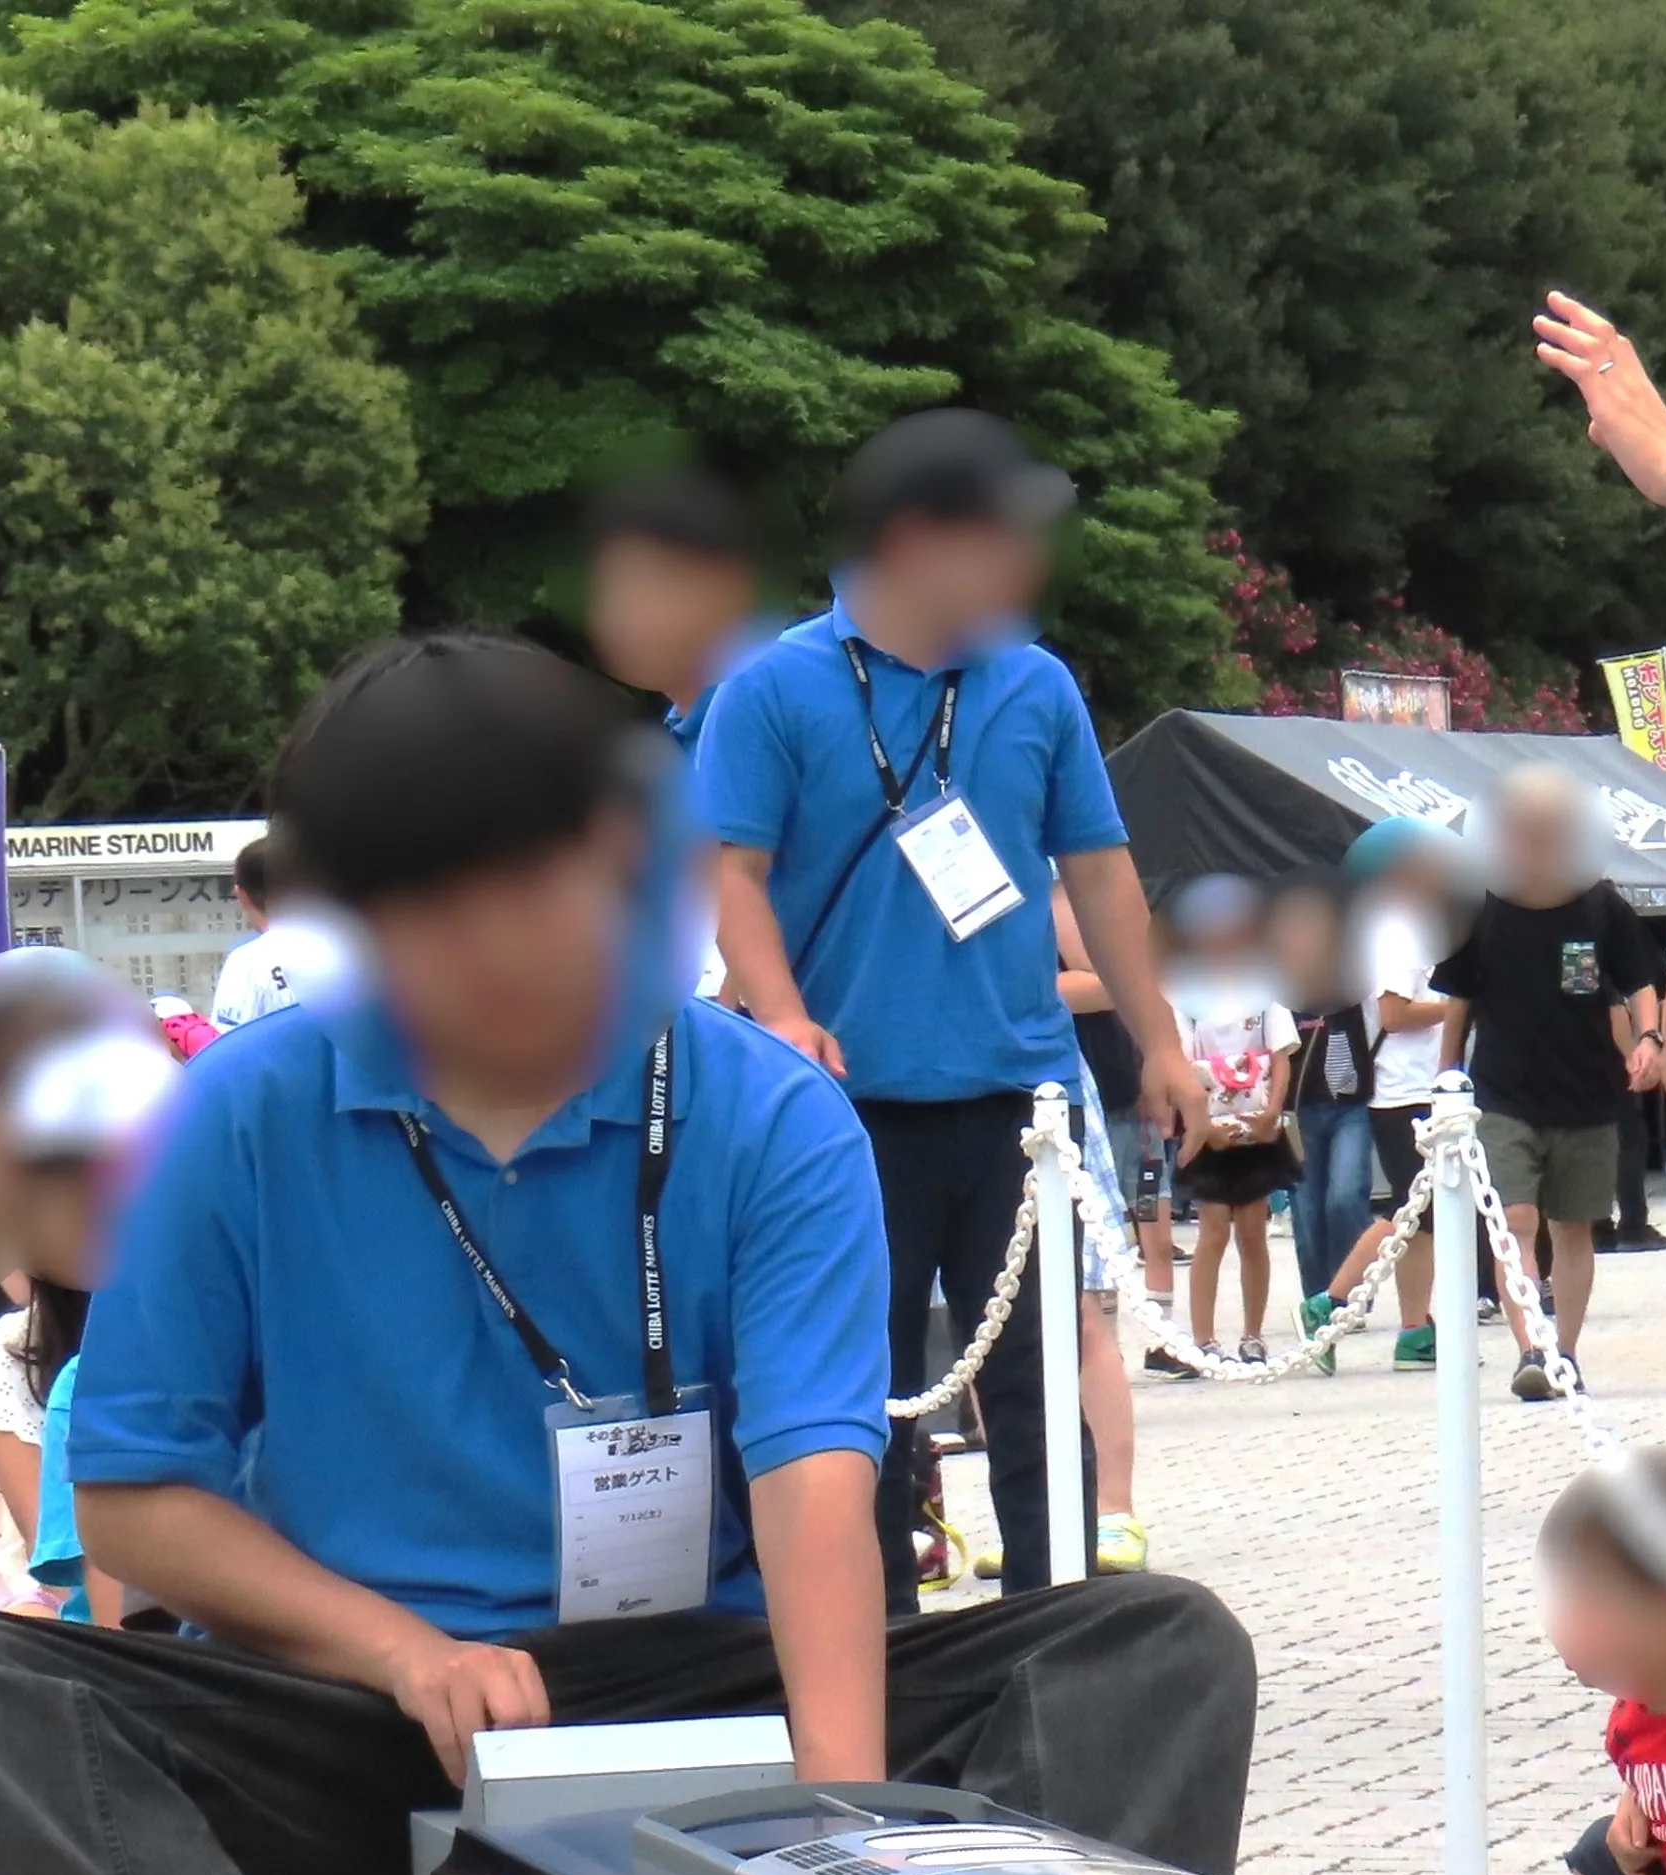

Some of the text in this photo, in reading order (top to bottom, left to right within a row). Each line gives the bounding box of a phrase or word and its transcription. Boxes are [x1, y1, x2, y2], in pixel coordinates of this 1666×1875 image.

[8, 835, 103, 858] MARINE
[106, 830, 214, 854] STADIUM
[651, 1078, 667, 1116] LOTTE
[648, 1118, 664, 1155] CHIBA
[482, 1269, 517, 1319] MARINES
[642, 1214, 664, 1350] CHIBA LOTTE MARINES
